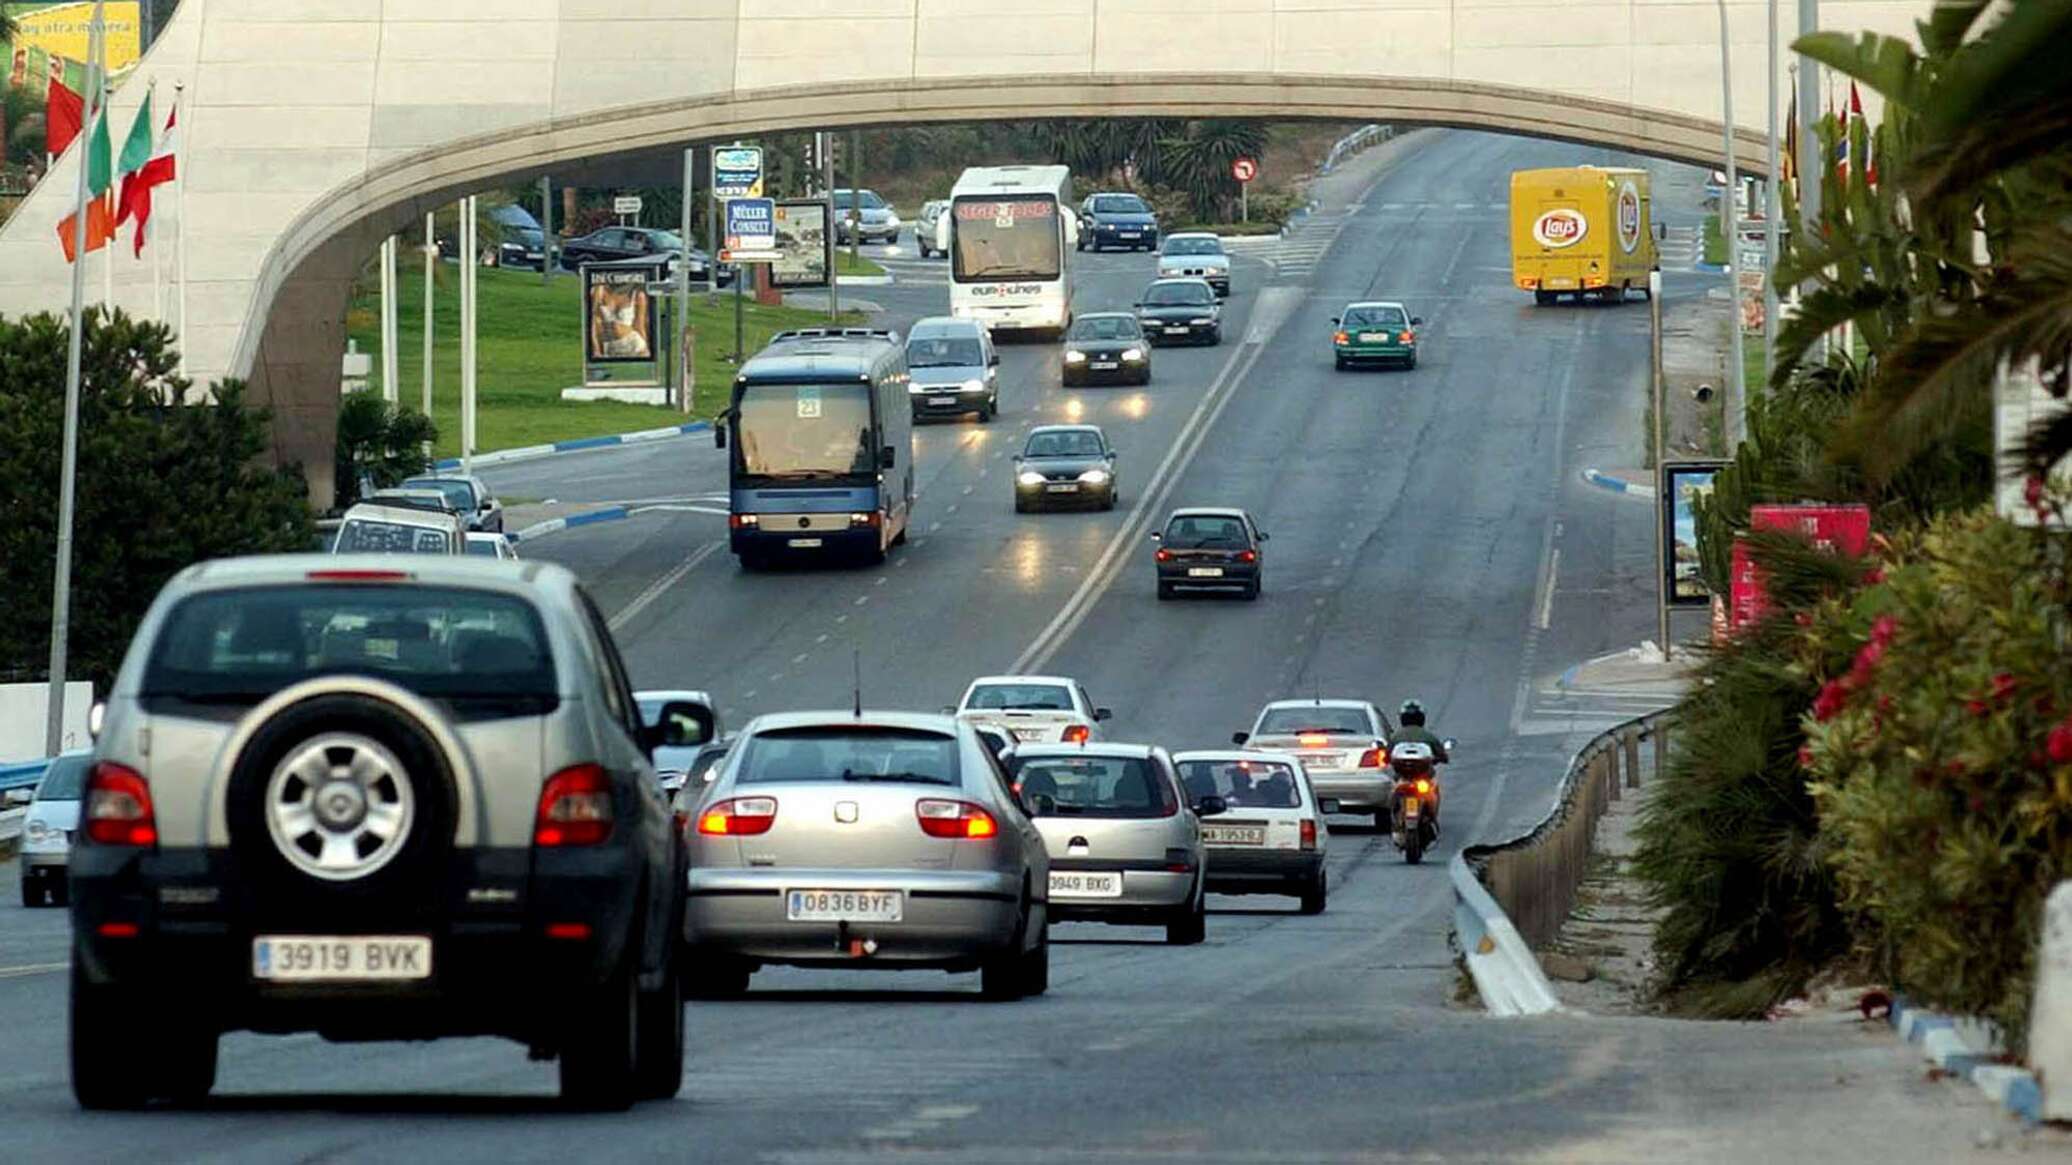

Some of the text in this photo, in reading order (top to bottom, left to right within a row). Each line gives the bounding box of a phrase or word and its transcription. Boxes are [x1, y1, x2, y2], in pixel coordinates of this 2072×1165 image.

[1050, 878, 1081, 890] 3949
[804, 894, 893, 912] 0836 BYF
[278, 943, 420, 971] 3919 BVK
